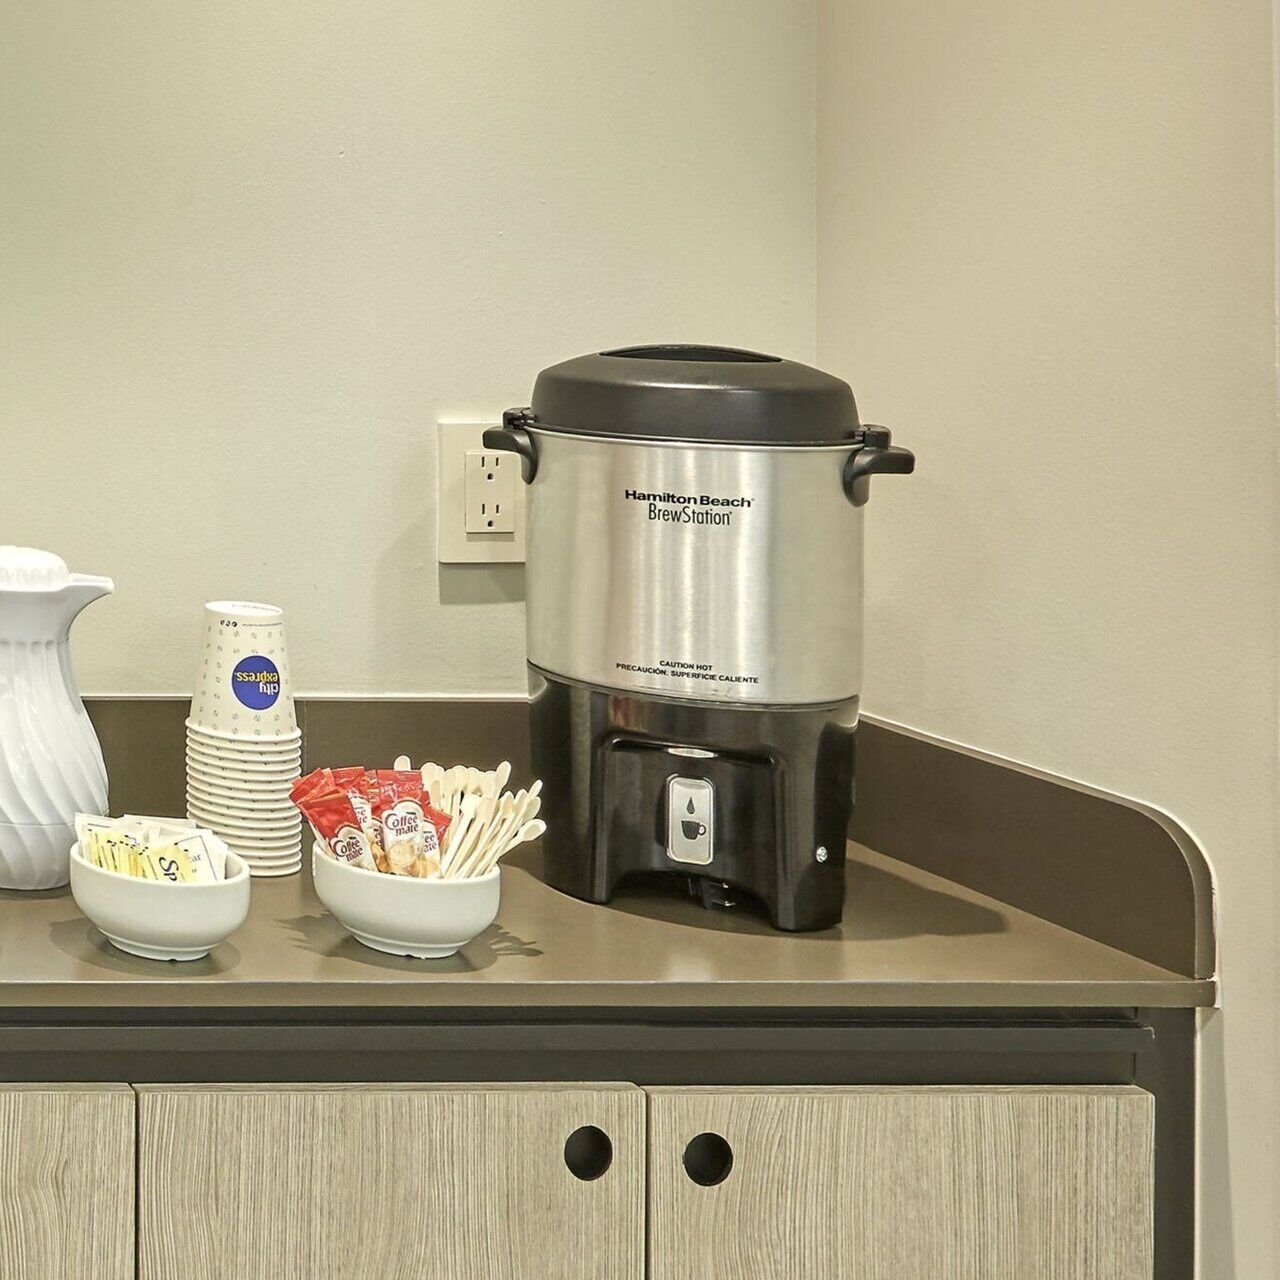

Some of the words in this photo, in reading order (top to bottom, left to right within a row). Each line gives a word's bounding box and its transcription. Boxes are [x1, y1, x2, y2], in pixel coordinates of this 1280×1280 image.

[624, 489, 697, 505] Hamilton
[699, 495, 752, 508] Beach
[648, 502, 731, 526] BrewStation
[659, 659, 694, 670] CAUTION
[696, 663, 713, 671] HOT
[235, 670, 279, 682] express
[670, 670, 717, 681] SUPERFICIE
[718, 674, 760, 684] CALIENTE
[259, 681, 279, 695] city
[385, 812, 419, 831] Coffee
[395, 822, 420, 837] mate
[333, 836, 361, 858] Coffee
[346, 846, 364, 862] mate
